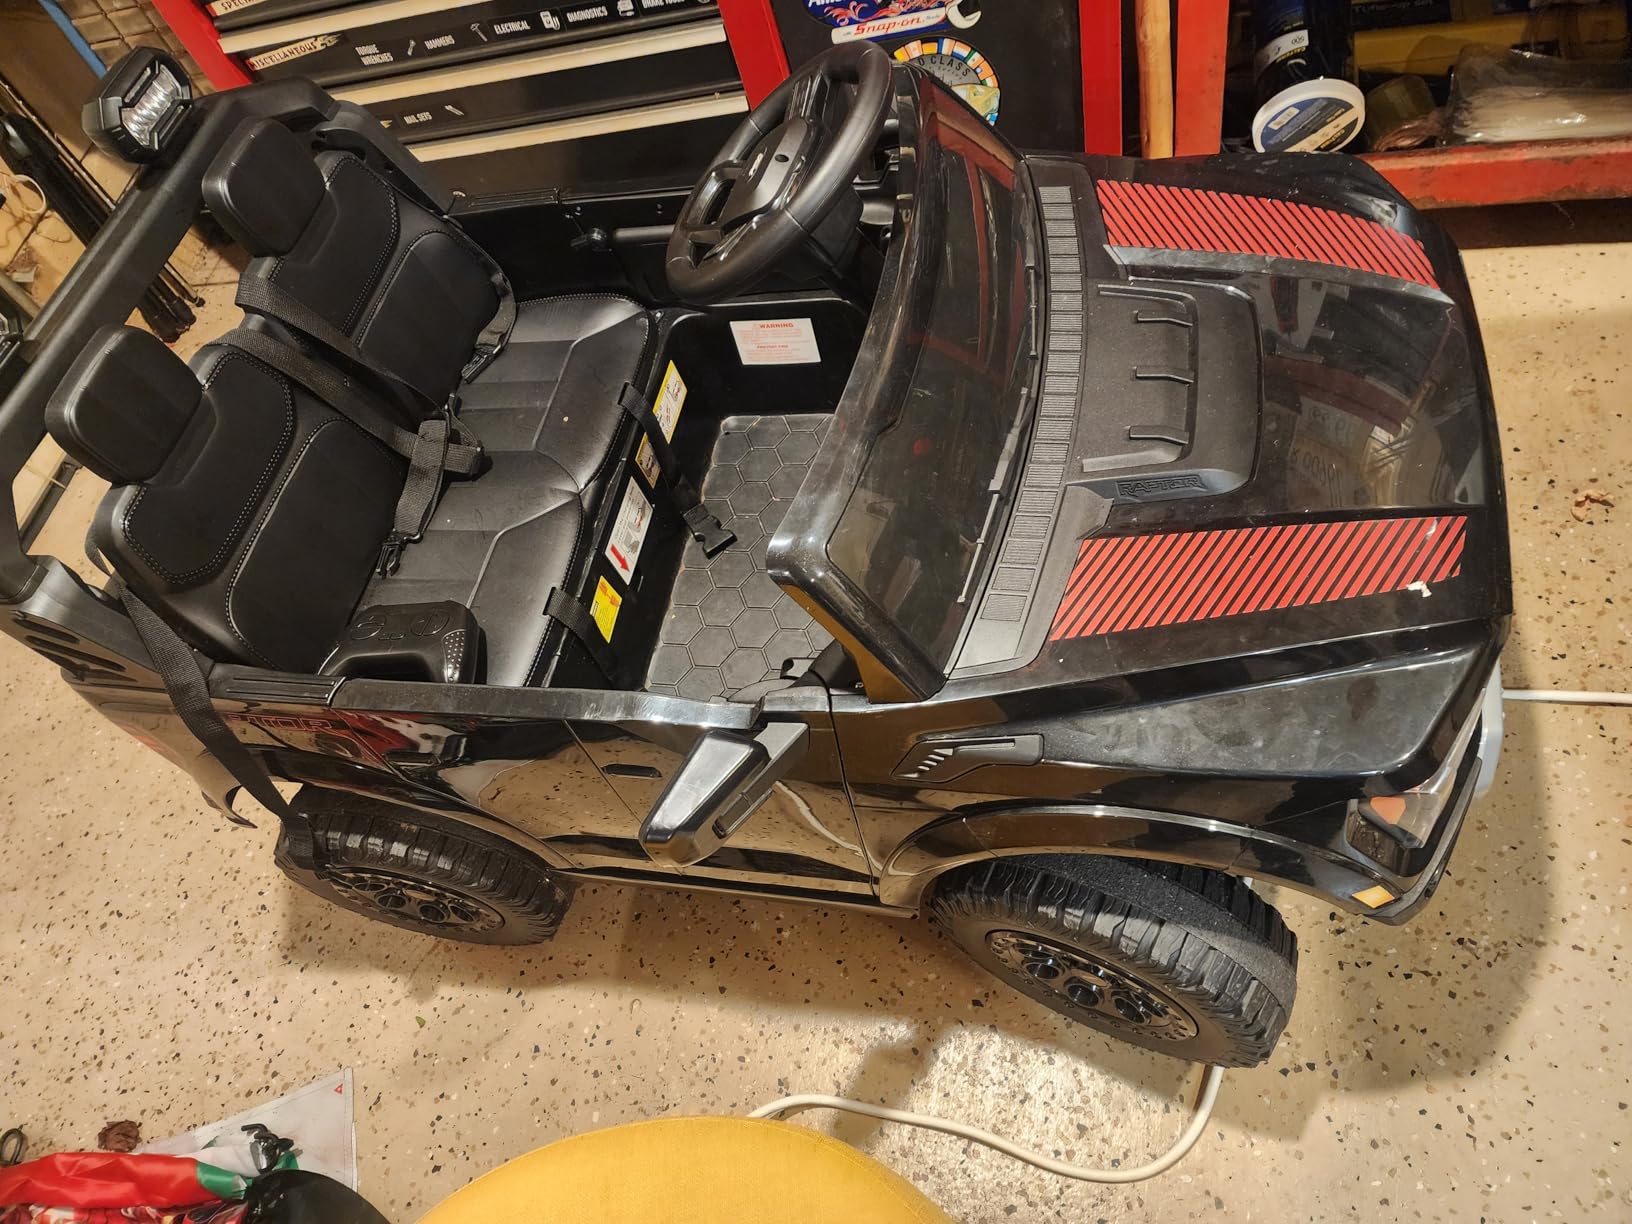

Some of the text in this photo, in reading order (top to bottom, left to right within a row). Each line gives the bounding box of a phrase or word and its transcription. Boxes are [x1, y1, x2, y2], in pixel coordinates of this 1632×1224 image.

[566, 6, 608, 22] DIAGNOSTICS
[493, 20, 531, 34] ELECTRICAL
[424, 34, 455, 50] HAMMERS
[248, 41, 317, 68] MISCELLANEOUS
[360, 52, 394, 65] WRENCHES
[930, 55, 970, 77] CLASS
[416, 112, 432, 122] SETS
[1116, 474, 1207, 499] RAPTOR
